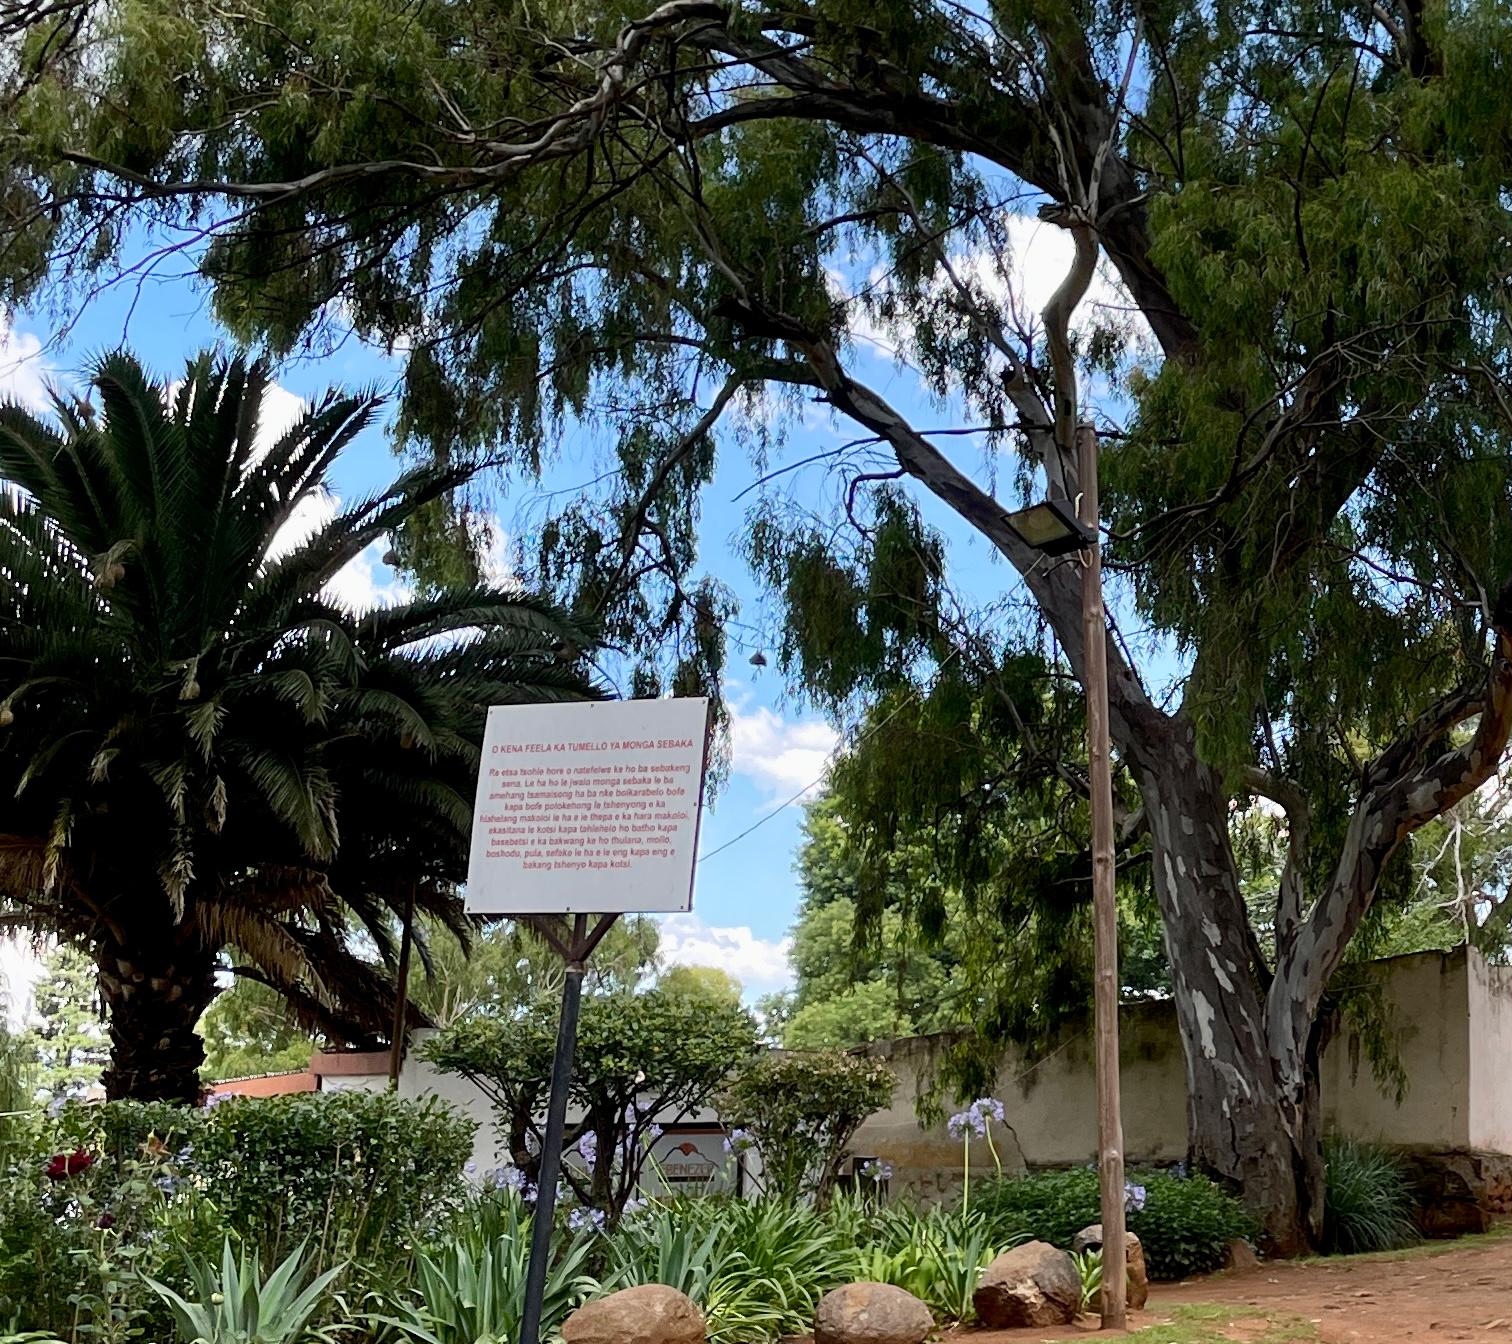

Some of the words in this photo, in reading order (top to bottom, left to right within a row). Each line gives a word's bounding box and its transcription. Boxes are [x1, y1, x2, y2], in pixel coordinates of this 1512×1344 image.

[500, 744, 524, 754] KENA
[524, 743, 552, 753] FEELA
[553, 743, 566, 752] KA
[567, 741, 608, 752] TUMELLO
[609, 741, 621, 751] YA
[621, 739, 655, 750] MONGA
[655, 738, 694, 749] SEBAKA
